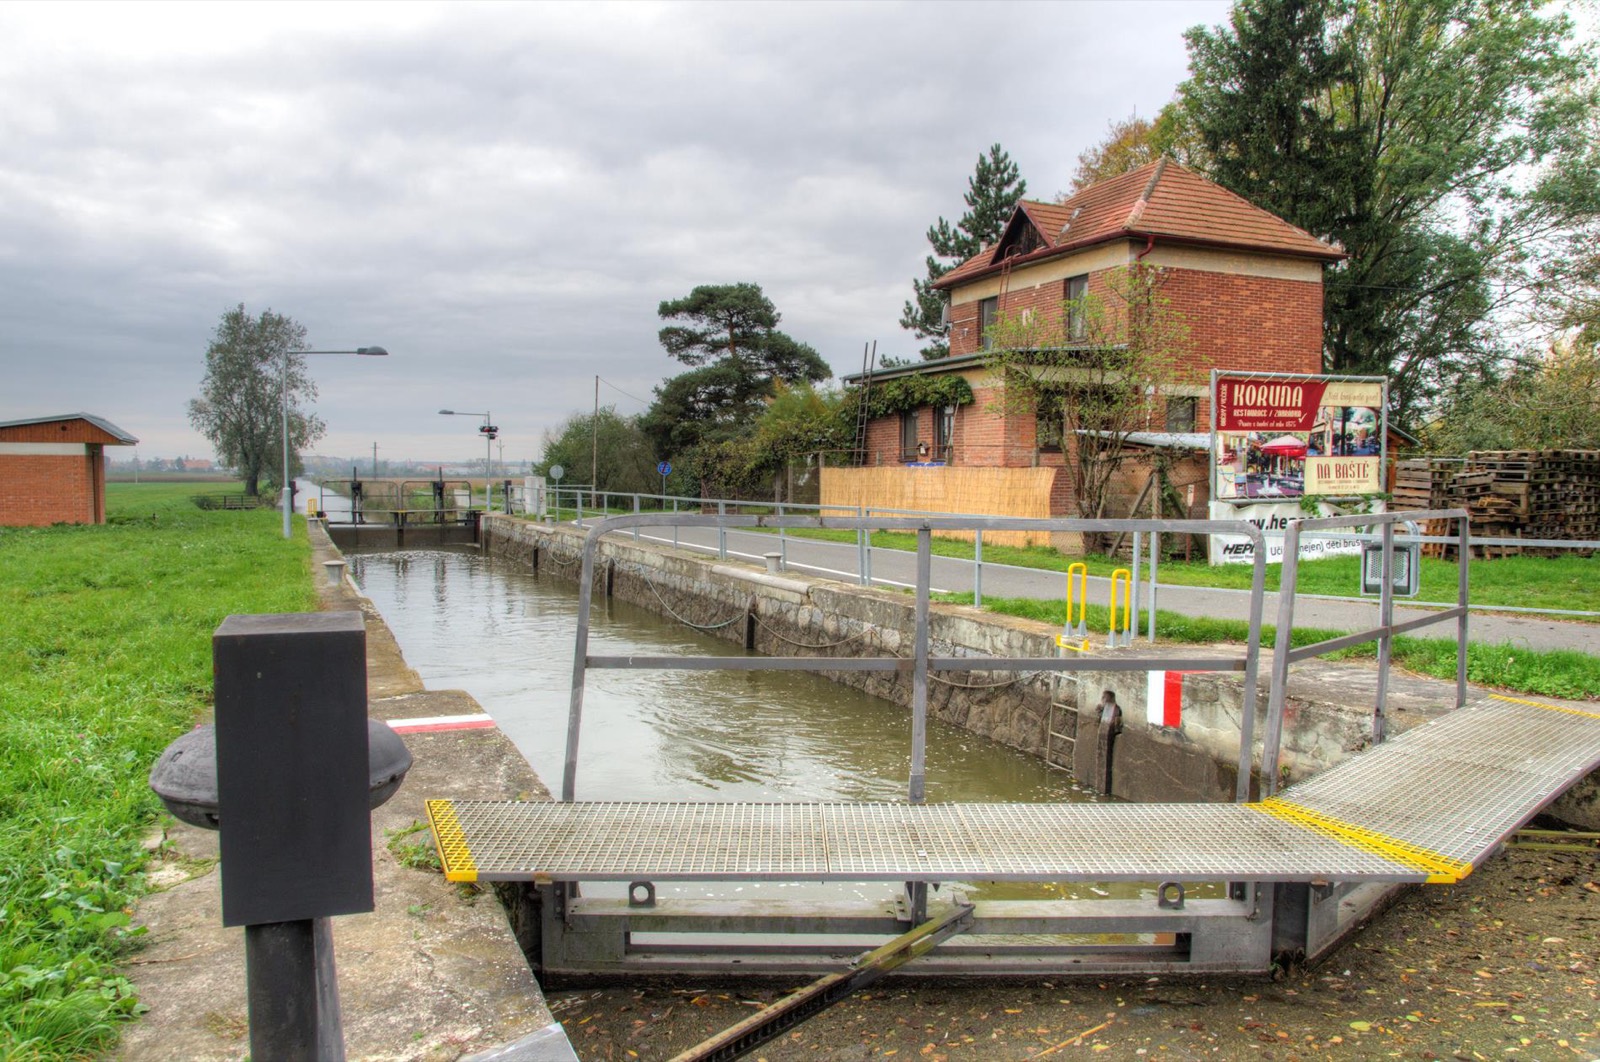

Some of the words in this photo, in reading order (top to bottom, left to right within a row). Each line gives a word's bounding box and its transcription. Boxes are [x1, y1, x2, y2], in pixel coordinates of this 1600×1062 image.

[1233, 384, 1303, 407] KORUNA
[1316, 463, 1331, 479] NA
[1335, 460, 1369, 479] BAŠTĚ
[1325, 539, 1341, 550] děti
